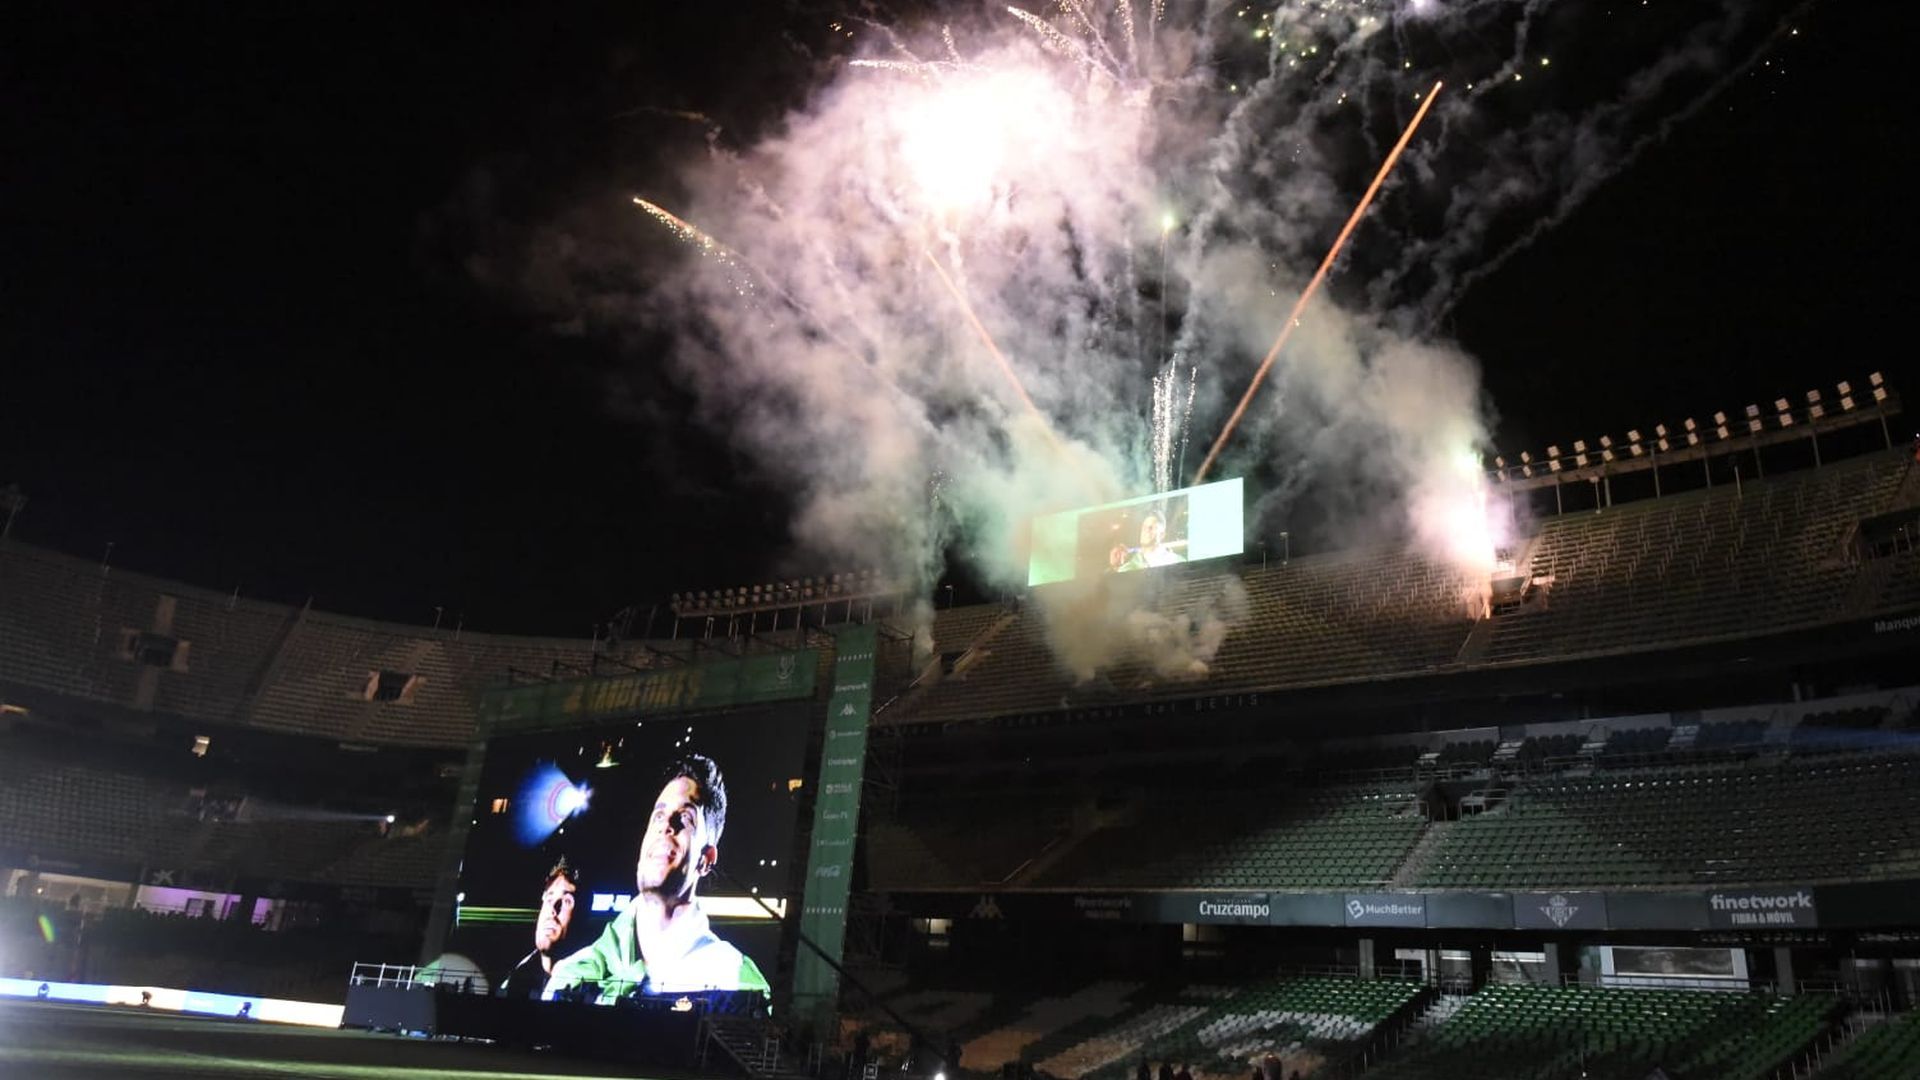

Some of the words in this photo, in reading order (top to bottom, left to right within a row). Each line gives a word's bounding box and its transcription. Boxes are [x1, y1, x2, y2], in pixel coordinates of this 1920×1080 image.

[1874, 615, 1920, 633] Manqu
[1199, 900, 1270, 919] Cruzcampo
[1365, 902, 1422, 914] MuchBetter
[1710, 891, 1813, 910] finetwork
